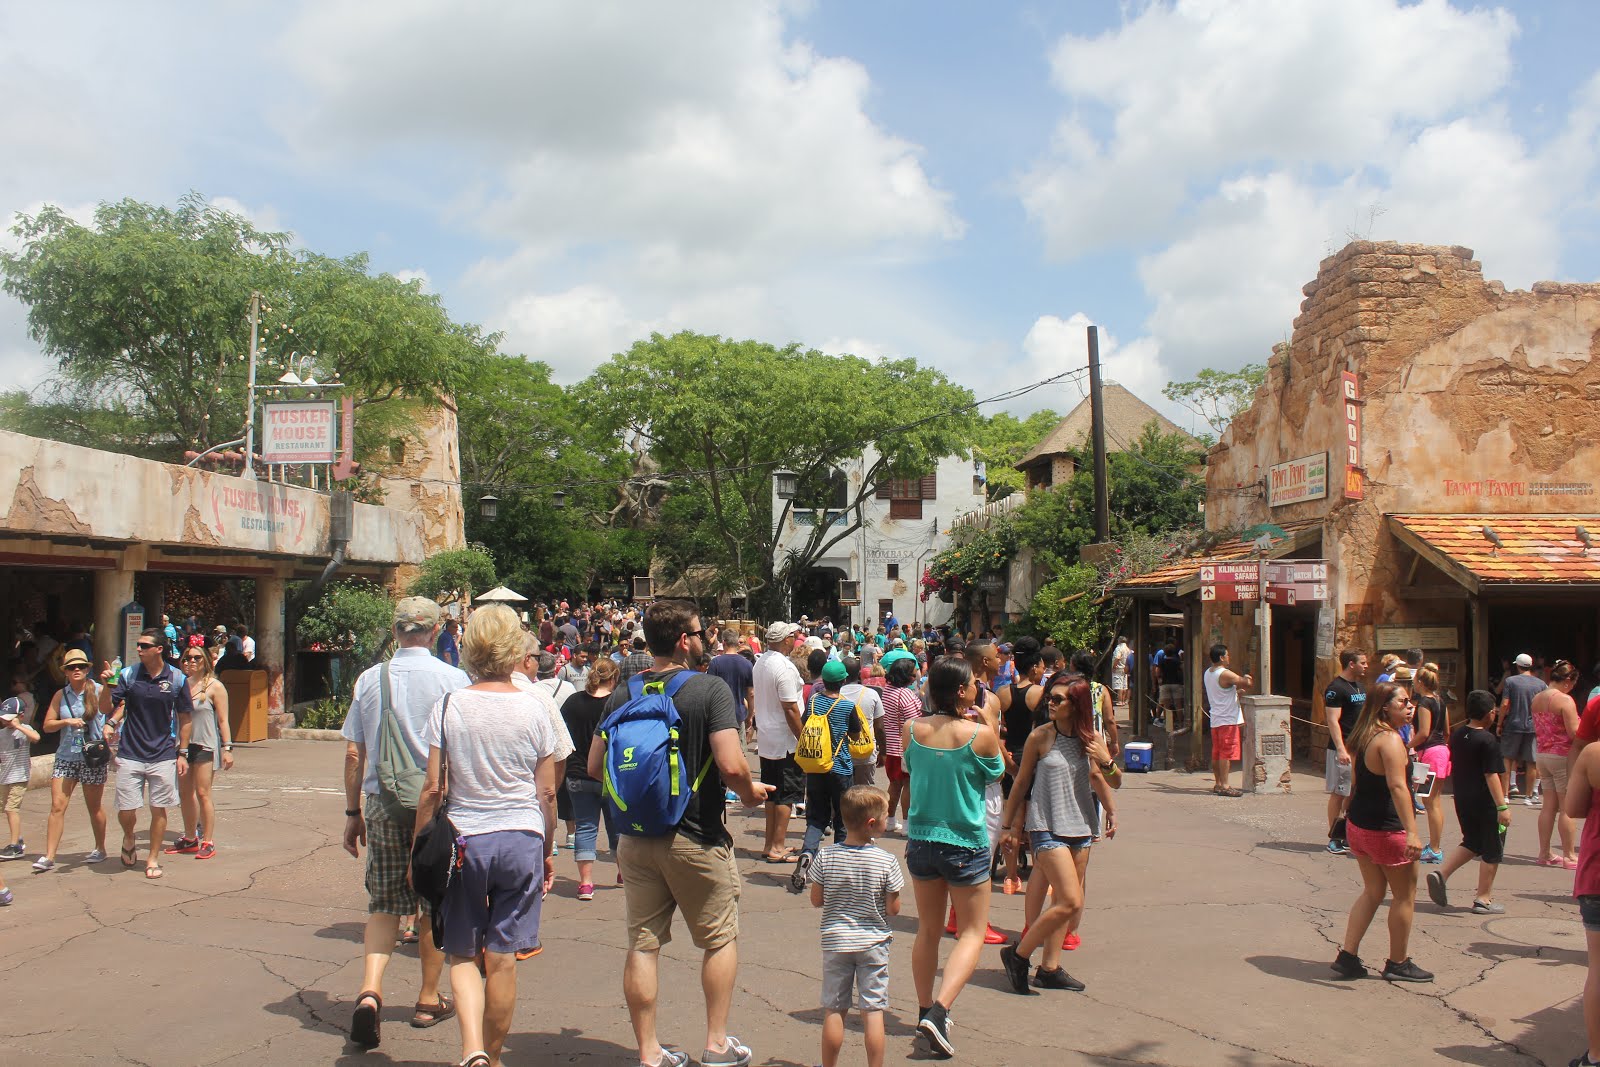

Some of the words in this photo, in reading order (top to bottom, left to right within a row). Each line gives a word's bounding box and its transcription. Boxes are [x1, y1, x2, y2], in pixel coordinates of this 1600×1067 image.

[269, 408, 330, 424] TUSKER
[1344, 380, 1357, 464] GOOD
[273, 426, 326, 440] HOUSE
[275, 442, 325, 450] RESTAURANT
[1443, 480, 1484, 496] TAMU
[1485, 480, 1525, 496] TAMU
[223, 487, 265, 514] TUSKER
[267, 495, 300, 518] HOUSE
[241, 516, 285, 533] RESTAURANT
[865, 550, 915, 559] MOMBASA
[1218, 566, 1258, 574] KILIMANJARO
[798, 748, 822, 759] BAND
[1262, 742, 1285, 756] 1961
